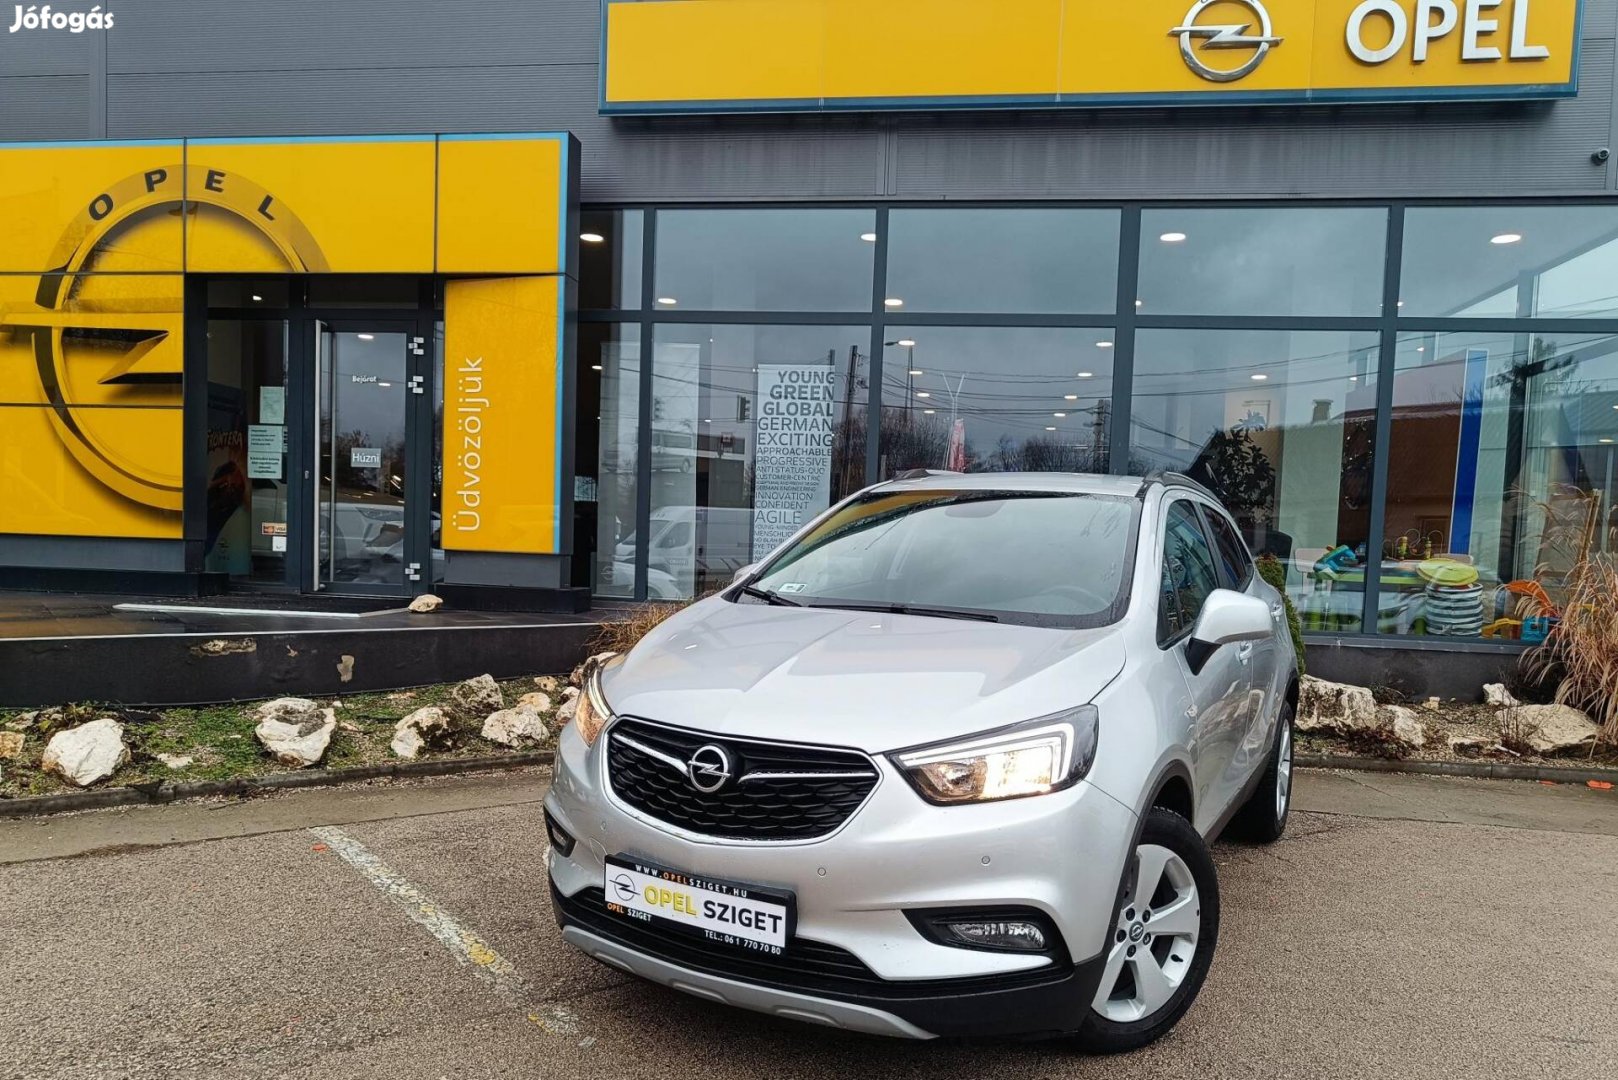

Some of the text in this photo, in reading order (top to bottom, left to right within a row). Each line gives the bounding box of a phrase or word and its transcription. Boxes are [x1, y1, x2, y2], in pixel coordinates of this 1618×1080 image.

[1345, 0, 1550, 66] OPEL
[88, 168, 276, 221] OPEL
[352, 375, 377, 383] Bejárat
[778, 371, 835, 384] YOUNG
[769, 384, 835, 400] GREEN
[763, 401, 834, 417] GLOBAL
[758, 417, 834, 432] GERMAN
[452, 356, 490, 531] Üdvözöljük
[757, 432, 833, 447] EXCITING
[352, 452, 380, 463] Húzni
[756, 447, 832, 456] APPROACHABLE
[756, 456, 828, 467] PROGRESSIVE
[756, 474, 821, 482] CUSTOMER-CENTRIC
[755, 491, 814, 501] INNOVATION
[755, 500, 810, 510] CONFIDENT
[755, 510, 801, 525] AGILE
[635, 864, 748, 898] WWW.OPELSZIGET.HU
[607, 902, 653, 922] OPEL SZIGET
[644, 885, 783, 934] OPEL SZIGET
[704, 929, 723, 942] TEL.:
[724, 934, 734, 944] 06
[743, 939, 758, 950] 770
[759, 942, 770, 953] 70
[771, 945, 782, 956] 80
